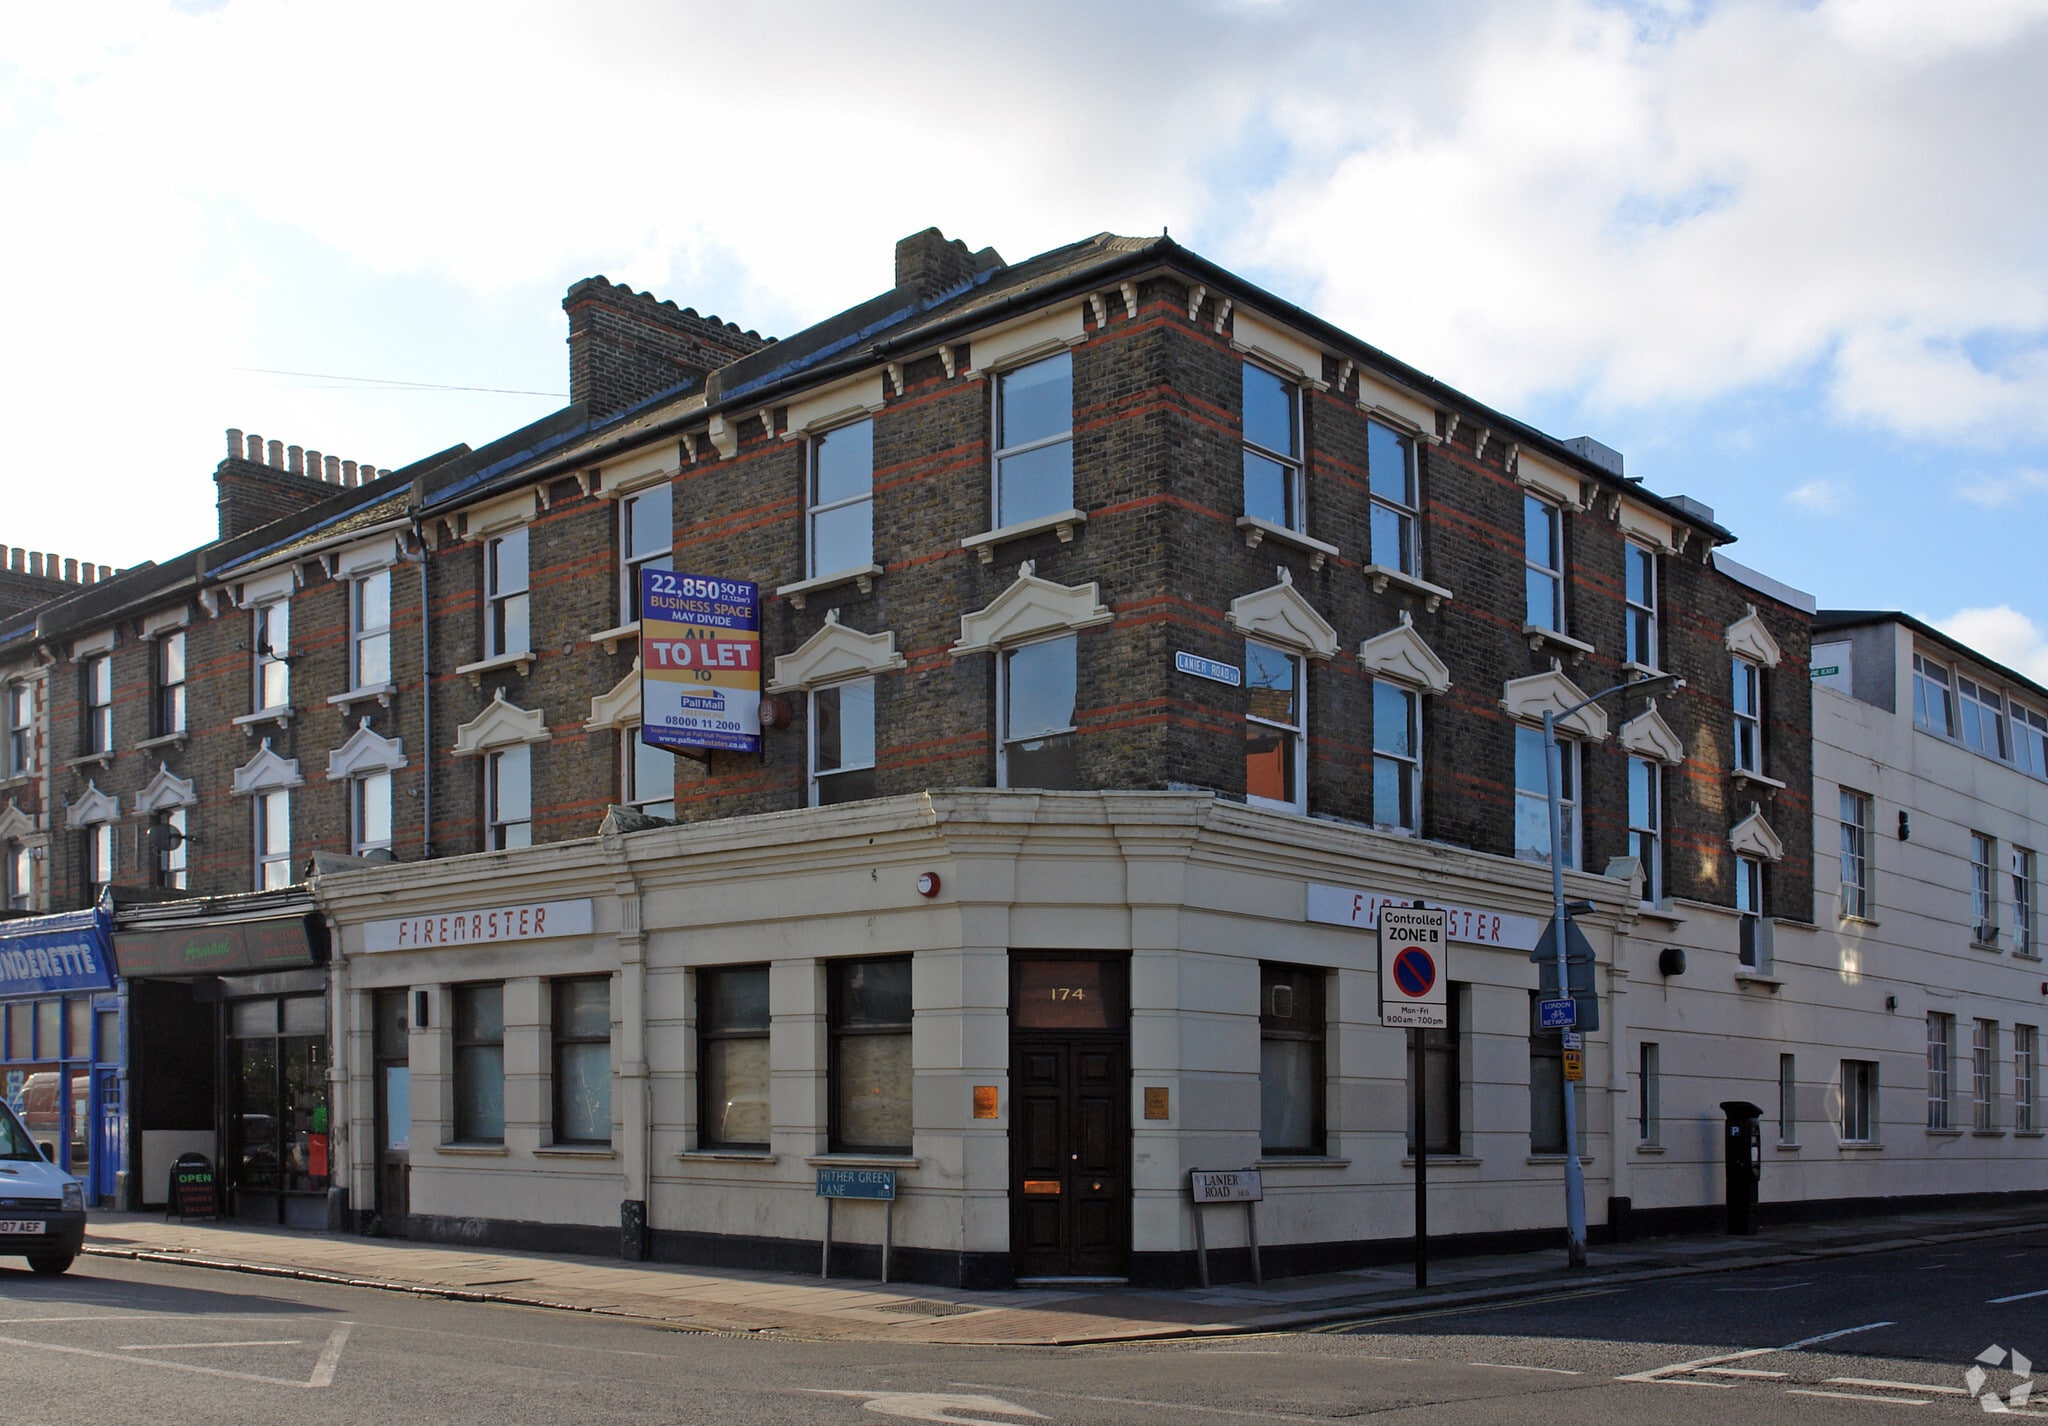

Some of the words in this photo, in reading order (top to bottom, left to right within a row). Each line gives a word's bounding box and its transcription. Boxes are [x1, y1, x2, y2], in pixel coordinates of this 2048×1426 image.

[651, 574, 720, 600] 22,850
[721, 582, 736, 595] SQ
[738, 585, 751, 595] FT
[650, 595, 710, 613] BUSINESS
[714, 602, 752, 618] SPACE
[672, 611, 694, 622] MAY
[696, 613, 731, 626] DIVIDE
[653, 642, 692, 666] TO
[700, 643, 752, 666] LET
[1178, 655, 1207, 673] LANIER
[1211, 664, 1230, 680] ROAD
[1821, 667, 1836, 675] EXIT
[693, 669, 712, 681] TO
[682, 697, 701, 709] Pall
[702, 699, 724, 711] Mall
[665, 715, 698, 727] 08000
[702, 719, 712, 729] 11
[715, 720, 741, 731] 2000
[658, 735, 748, 750] www.pallmallestates.co.uk
[1352, 894, 1500, 942] FISTER
[1385, 912, 1442, 926] Controlled
[399, 908, 546, 945] FIREMASTER
[1389, 927, 1427, 941] ZONE
[1430, 930, 1438, 942] L
[0, 943, 96, 981] NDERETTE
[1051, 988, 1085, 1000] 174
[1544, 1001, 1571, 1010] LONDON
[1543, 1018, 1573, 1027] NETWORK
[1731, 1126, 1740, 1136] P
[179, 1174, 212, 1183] OPEN
[820, 1171, 855, 1182] HITHER
[858, 1172, 891, 1183] GREEN
[1204, 1175, 1239, 1186] LANIER
[820, 1184, 846, 1196] LANE
[1205, 1186, 1230, 1198] ROAD
[0, 1222, 16, 1232] 07
[19, 1222, 40, 1232] AEF
